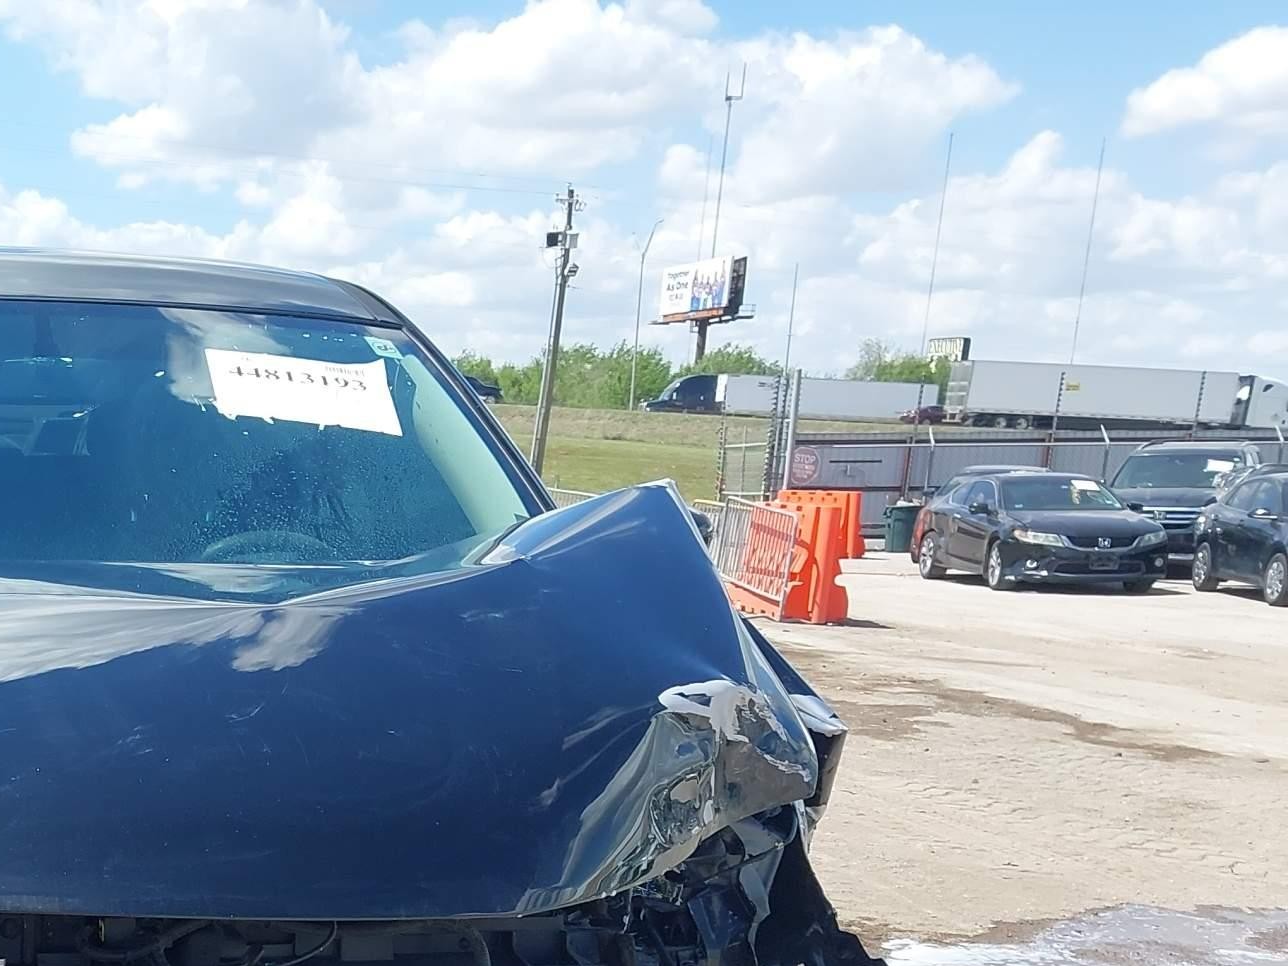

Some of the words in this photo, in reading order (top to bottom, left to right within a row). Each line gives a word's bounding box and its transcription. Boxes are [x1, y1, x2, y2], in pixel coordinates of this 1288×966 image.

[676, 281, 689, 290] One
[229, 366, 367, 391] 44813193
[794, 453, 816, 464] STOP
